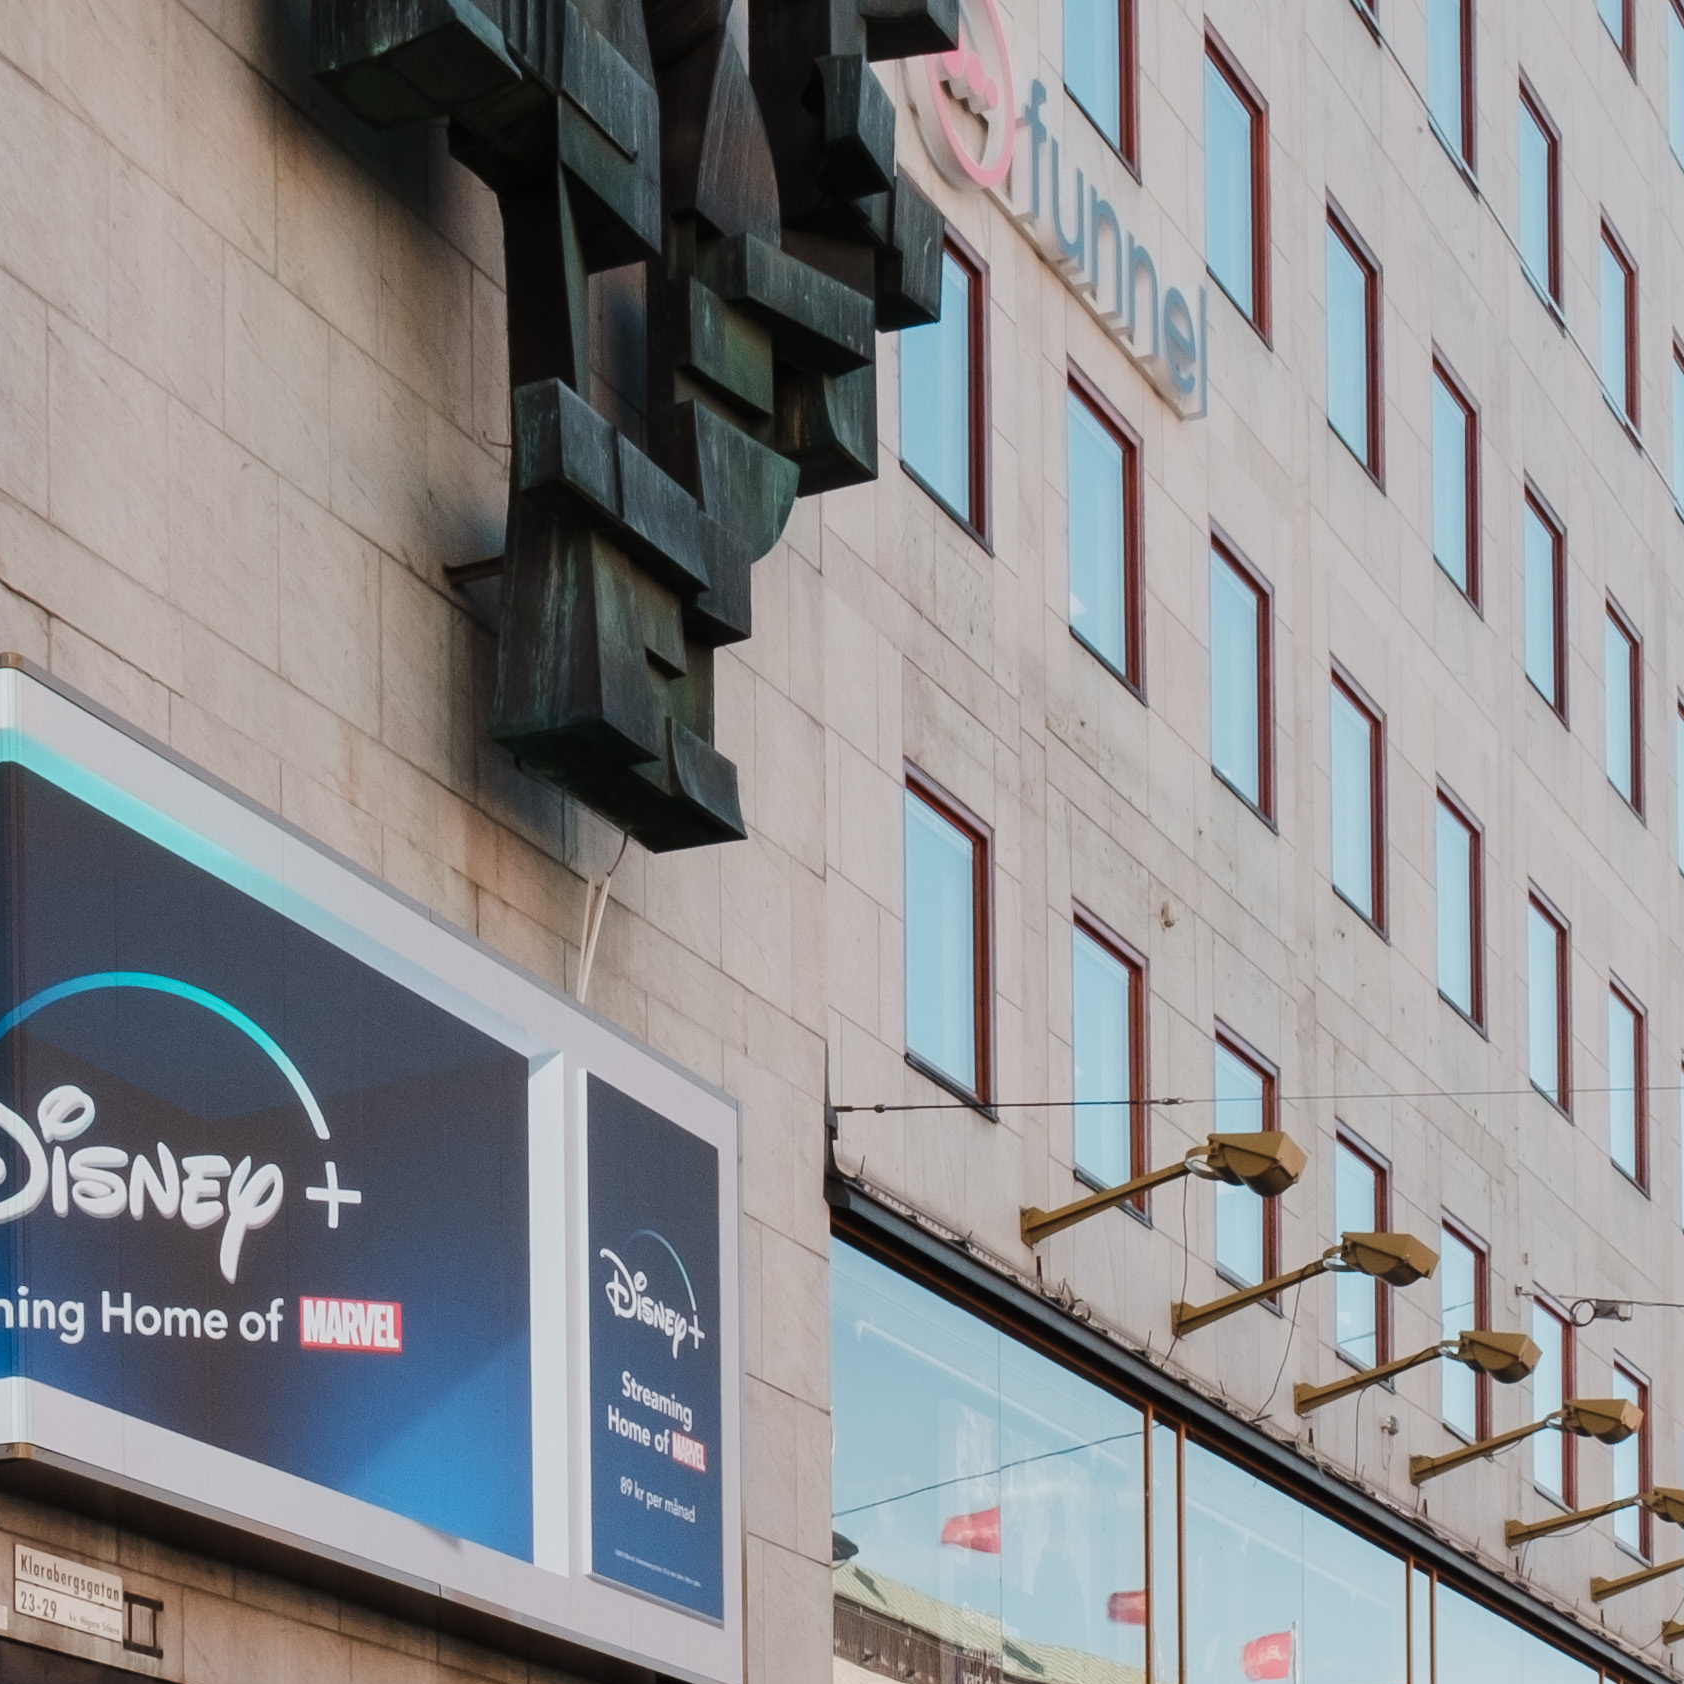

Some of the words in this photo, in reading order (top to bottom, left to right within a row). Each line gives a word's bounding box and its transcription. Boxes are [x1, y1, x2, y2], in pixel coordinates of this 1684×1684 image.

[1019, 79, 1208, 420] funnel
[101, 1291, 228, 1342] Home
[239, 1298, 285, 1342] of
[303, 1300, 399, 1349] MARVEL
[621, 1370, 693, 1431] Streaming
[608, 1405, 650, 1448] Home
[654, 1429, 670, 1455] of
[672, 1433, 705, 1471] MARVEL
[620, 1476, 633, 1496] 89
[634, 1481, 644, 1500] kr
[646, 1489, 662, 1510] per
[664, 1494, 696, 1523] månad
[20, 1554, 119, 1602] Klarabergsgatan
[20, 1591, 57, 1619] 23-29
